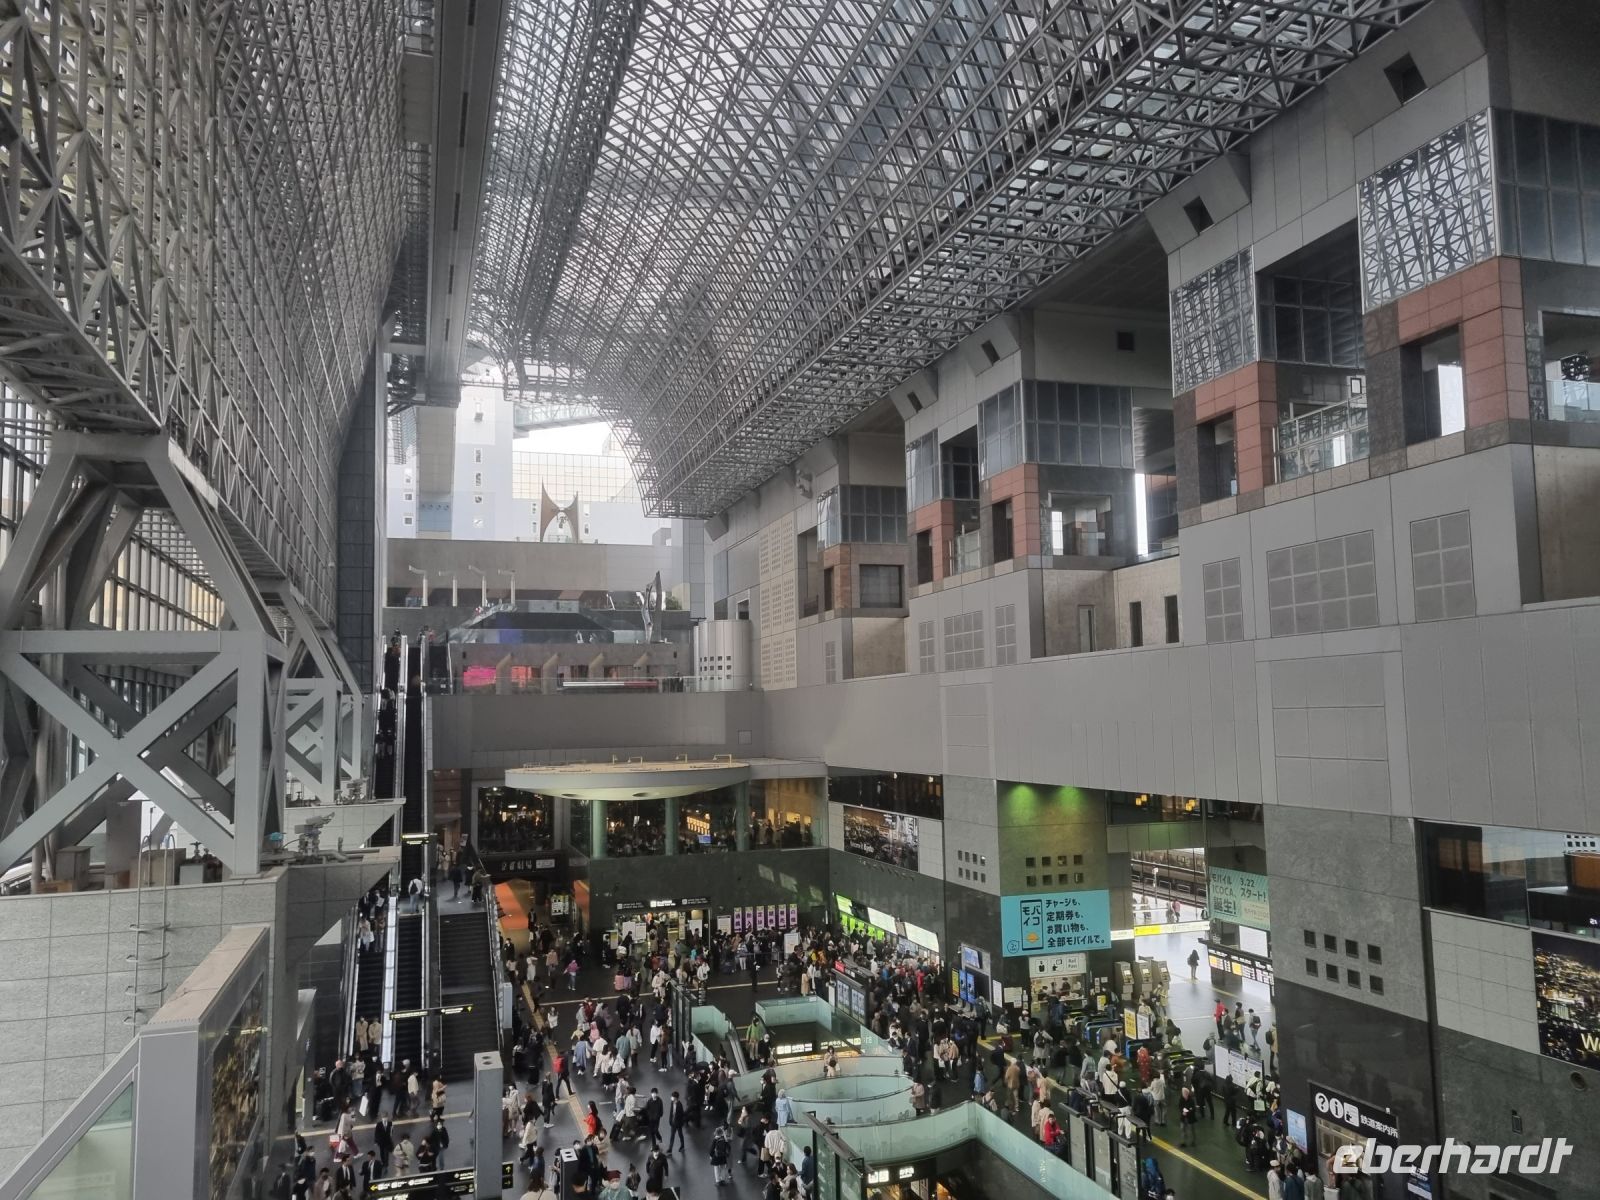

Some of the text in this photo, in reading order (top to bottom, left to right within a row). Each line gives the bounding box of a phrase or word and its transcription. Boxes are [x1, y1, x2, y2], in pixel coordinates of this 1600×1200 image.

[1211, 873, 1232, 885] モバイル
[1240, 877, 1255, 888] 3.22
[1045, 898, 1081, 909] チャージも、
[1022, 905, 1041, 916] モバ
[1046, 910, 1084, 922] 定期券も、
[1023, 917, 1040, 927] イコ
[1046, 922, 1089, 935] お買い物も、
[1047, 935, 1105, 948] 全部モバイルで。
